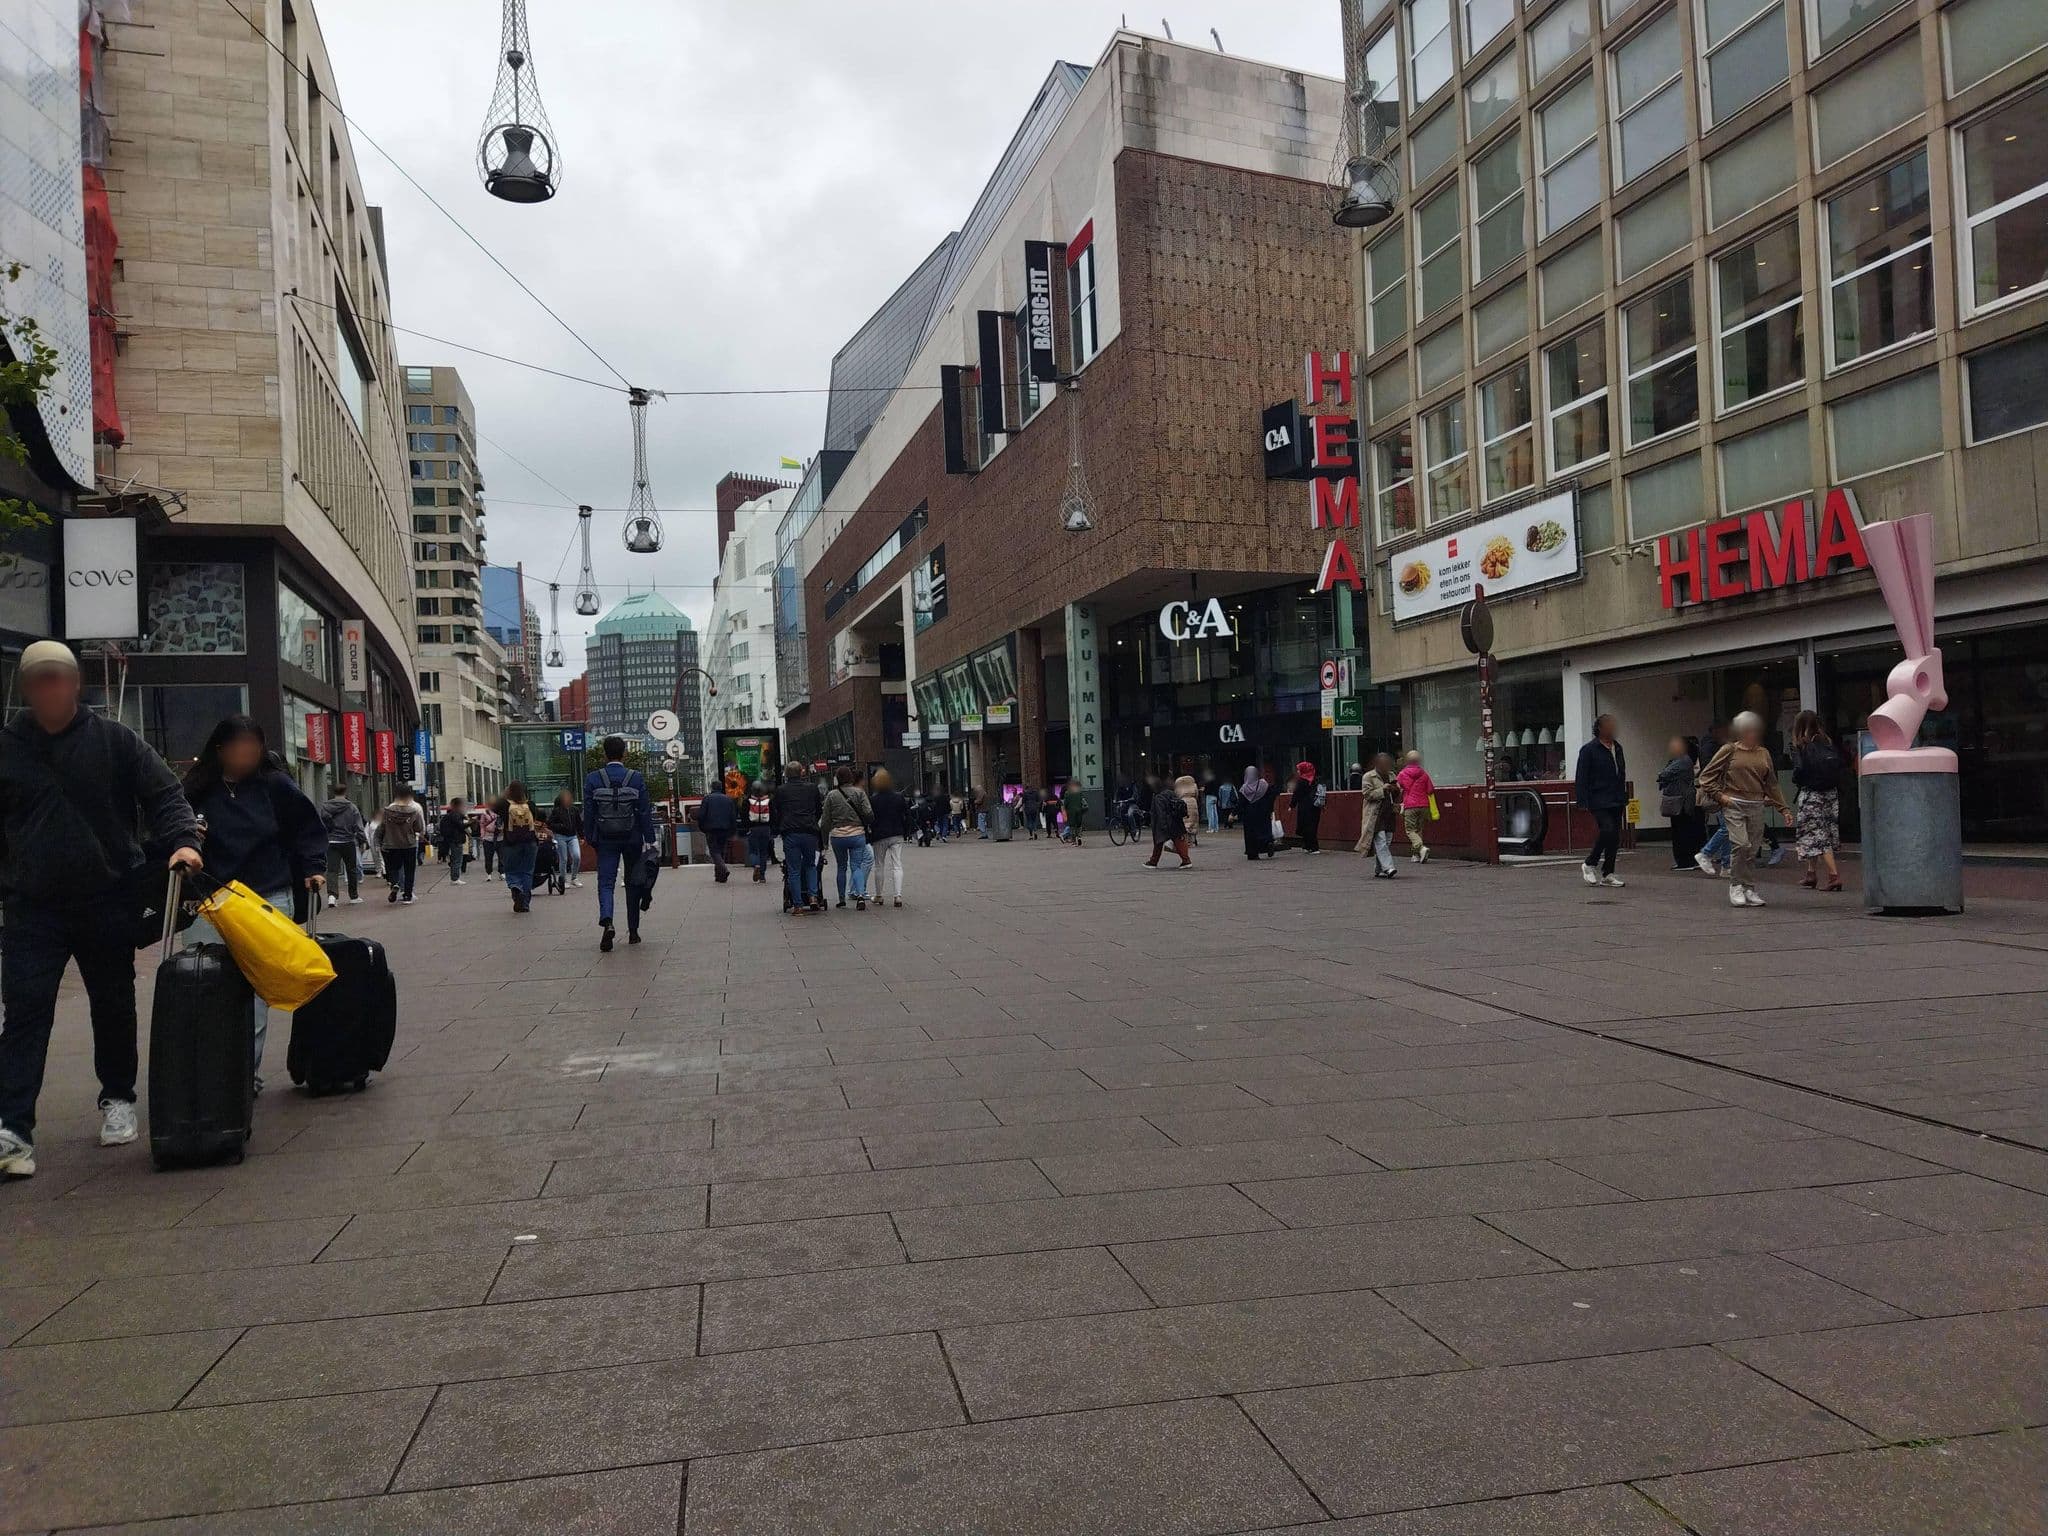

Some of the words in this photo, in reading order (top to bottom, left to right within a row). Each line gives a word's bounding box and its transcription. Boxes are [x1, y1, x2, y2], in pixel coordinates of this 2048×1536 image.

[1030, 267, 1051, 350] BASIC-FIT
[1265, 425, 1292, 452] C&A
[1304, 351, 1364, 592] HEMA
[1656, 487, 1870, 609] HEMA
[1439, 564, 1452, 577] kom
[1452, 559, 1471, 573] lekker
[1439, 576, 1453, 589] eten
[1453, 575, 1459, 584] in
[1460, 573, 1471, 583] ons
[1440, 584, 1471, 601] restaurant
[1160, 597, 1234, 641] C&A
[349, 644, 358, 682] COURIR
[1080, 607, 1097, 787] SPUIMARKT
[564, 732, 573, 746] P
[1219, 723, 1246, 743] C&A
[401, 746, 411, 781] GUESS
